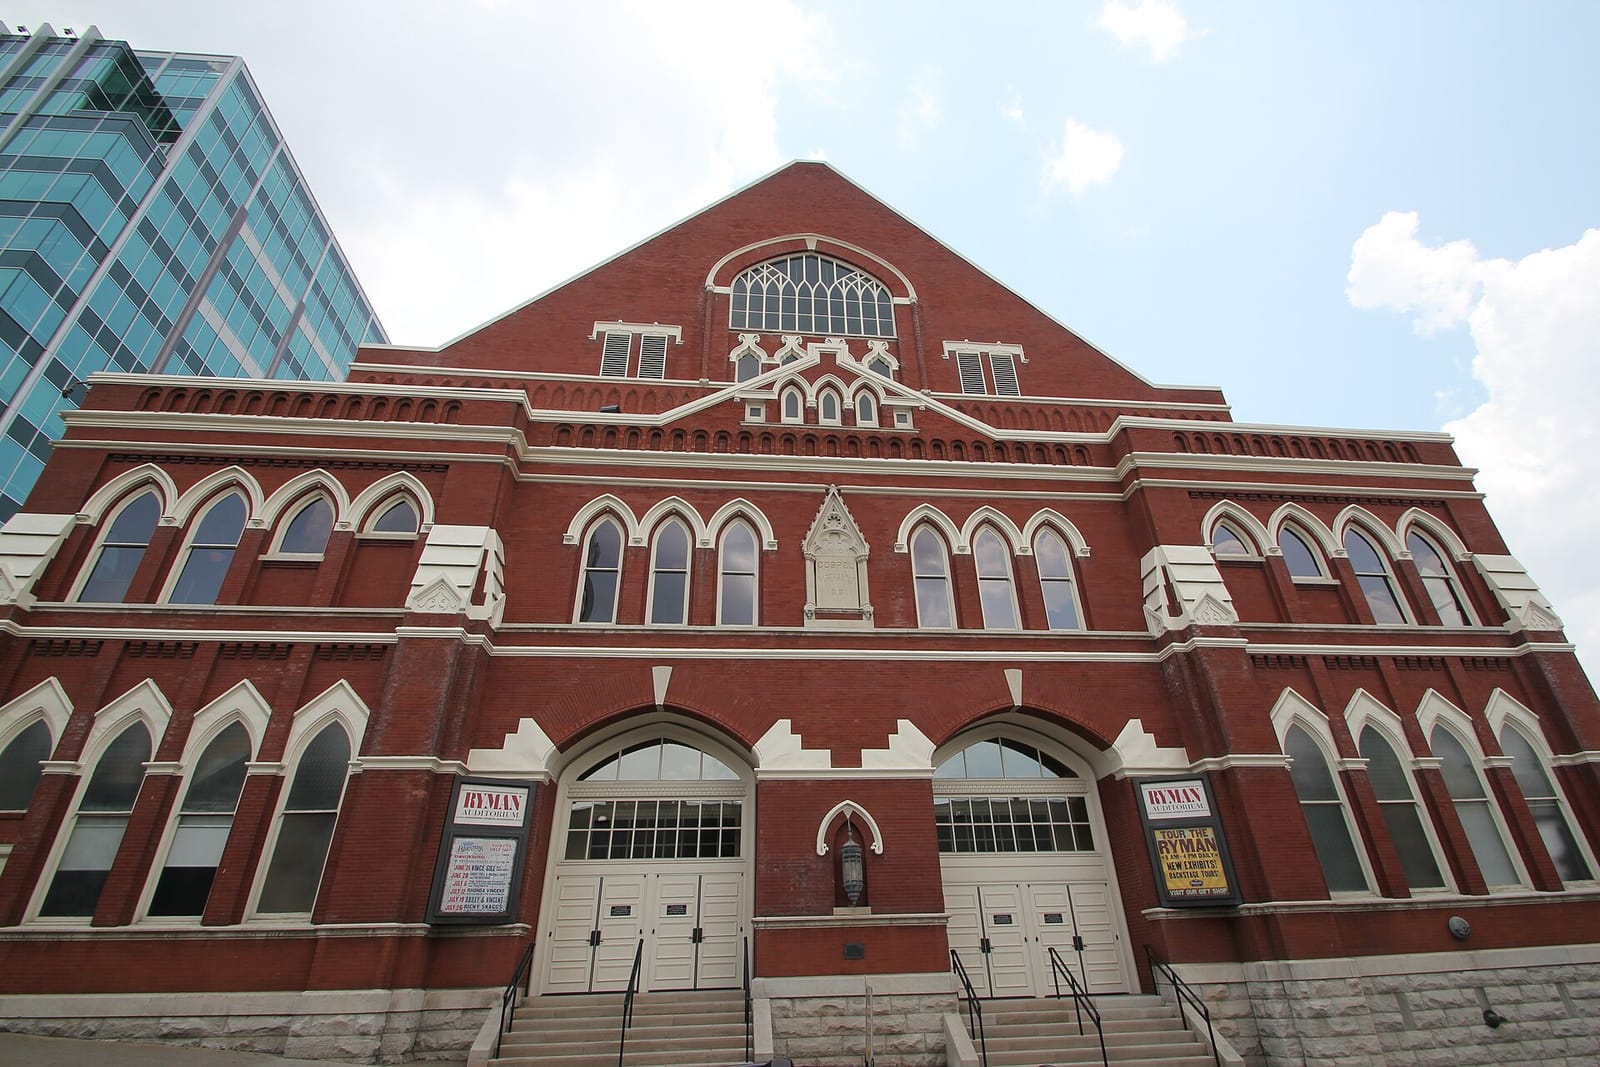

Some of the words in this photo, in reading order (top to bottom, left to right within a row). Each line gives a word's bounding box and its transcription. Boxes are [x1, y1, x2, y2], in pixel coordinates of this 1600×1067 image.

[464, 792, 522, 810] RYMAN
[1148, 787, 1201, 805] RYMAN
[1153, 803, 1205, 812] AUDITORIUM
[464, 809, 520, 818] AUDITORIUM
[1160, 830, 1187, 839] TOUR
[1188, 828, 1208, 838] THE
[1157, 837, 1218, 854] RYMAN
[1166, 861, 1182, 870] NEW
[1184, 859, 1218, 870] EXHIBITS!
[1169, 870, 1200, 879] BACKSTAGE
